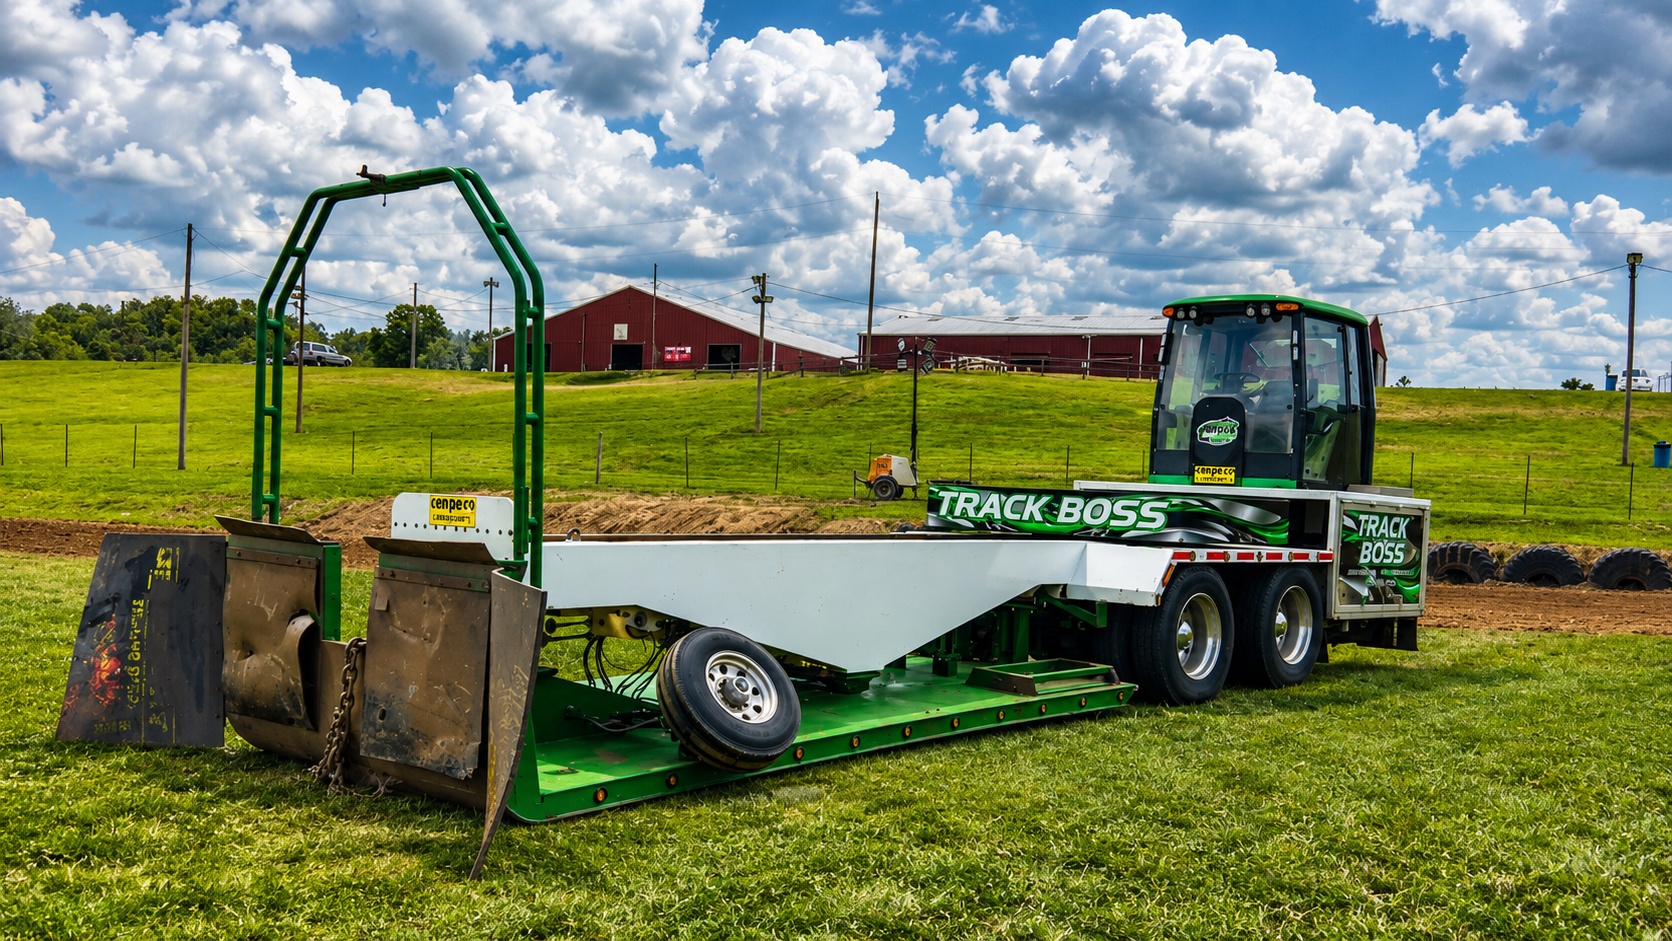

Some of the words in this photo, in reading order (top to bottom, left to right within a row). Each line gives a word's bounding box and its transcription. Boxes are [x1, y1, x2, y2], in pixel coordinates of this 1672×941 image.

[431, 497, 475, 514] cenpeco
[938, 491, 1049, 522] TRACK
[1057, 496, 1169, 529] BOSS
[1359, 514, 1410, 539] TRACK
[1359, 541, 1406, 564] BOSS
